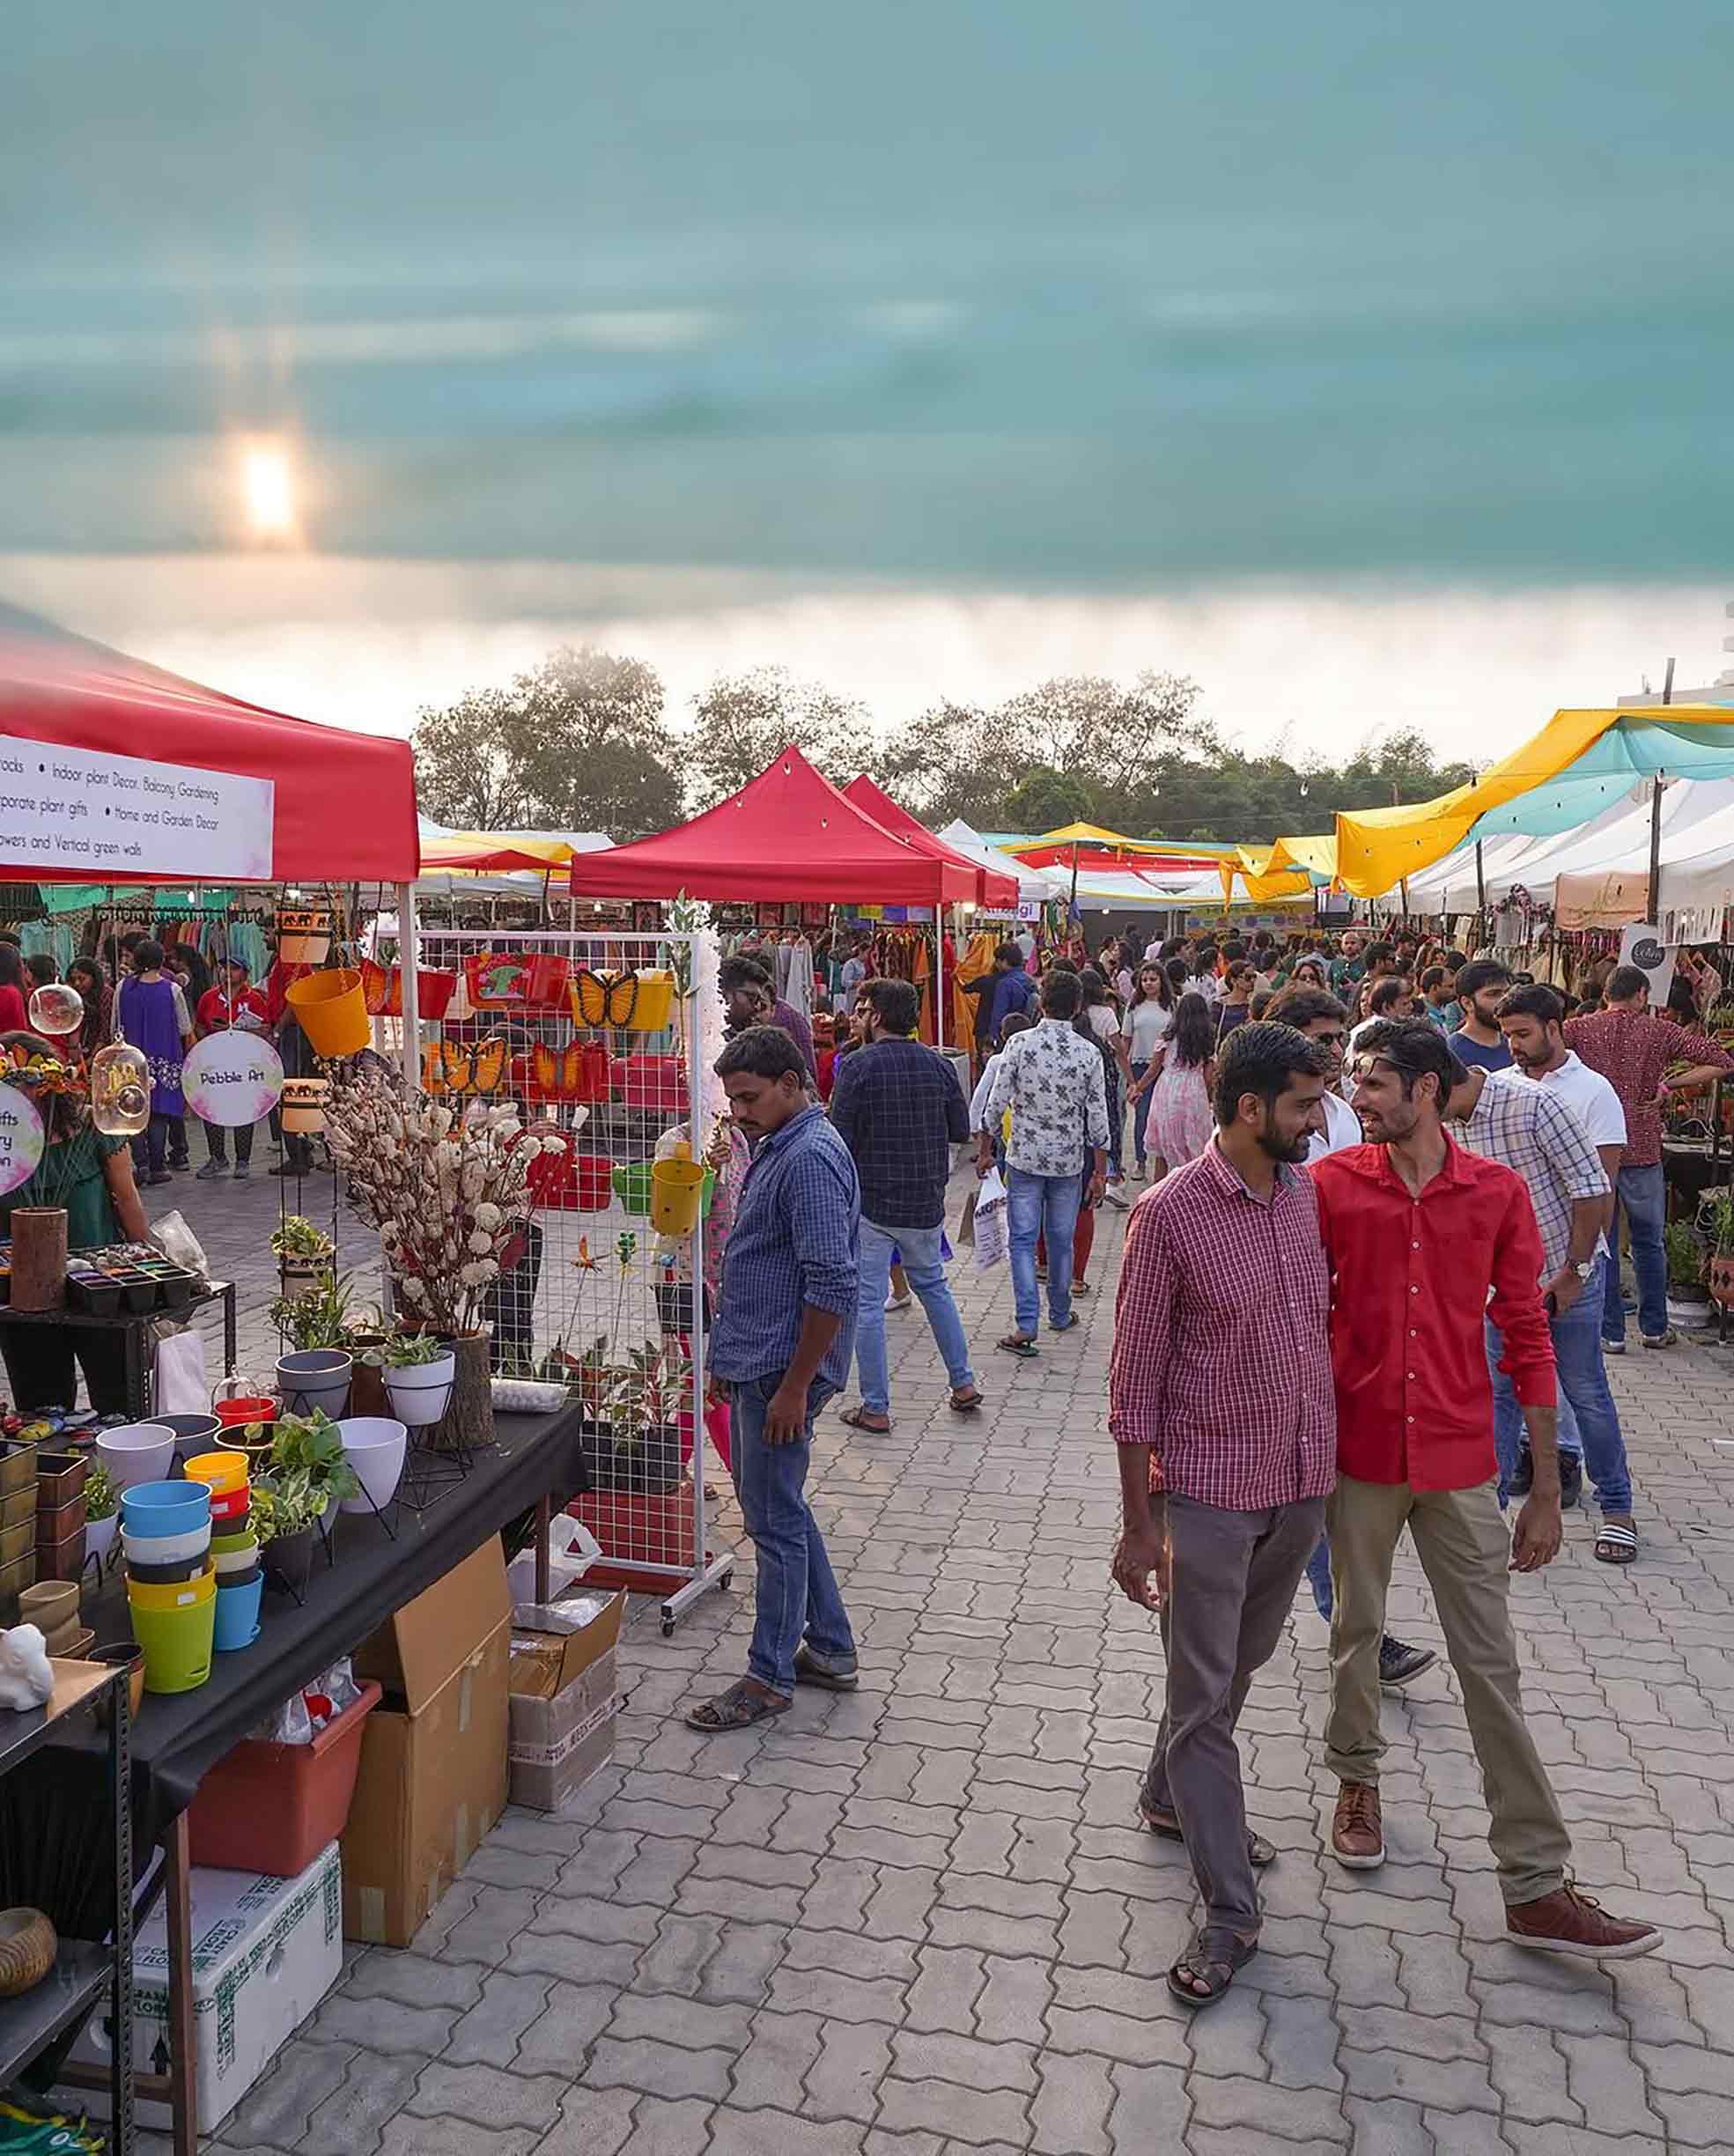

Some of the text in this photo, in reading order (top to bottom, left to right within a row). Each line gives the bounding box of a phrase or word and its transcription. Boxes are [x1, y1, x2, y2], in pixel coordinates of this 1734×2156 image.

[52, 762, 82, 781] Indoor
[85, 768, 109, 788] plant
[144, 775, 175, 800] Balcony
[178, 781, 218, 806] Gardening
[41, 796, 64, 816] plant
[70, 799, 87, 820] gifts
[114, 806, 139, 822] Home
[143, 809, 159, 824] and
[161, 809, 194, 827] Garden
[196, 814, 218, 831] Decor
[32, 832, 50, 850] and
[55, 832, 90, 853] Vertical
[94, 842, 119, 859] green
[124, 841, 142, 857] walls
[201, 1069, 265, 1085] Pebble Art
[0, 1156, 11, 1167] n
